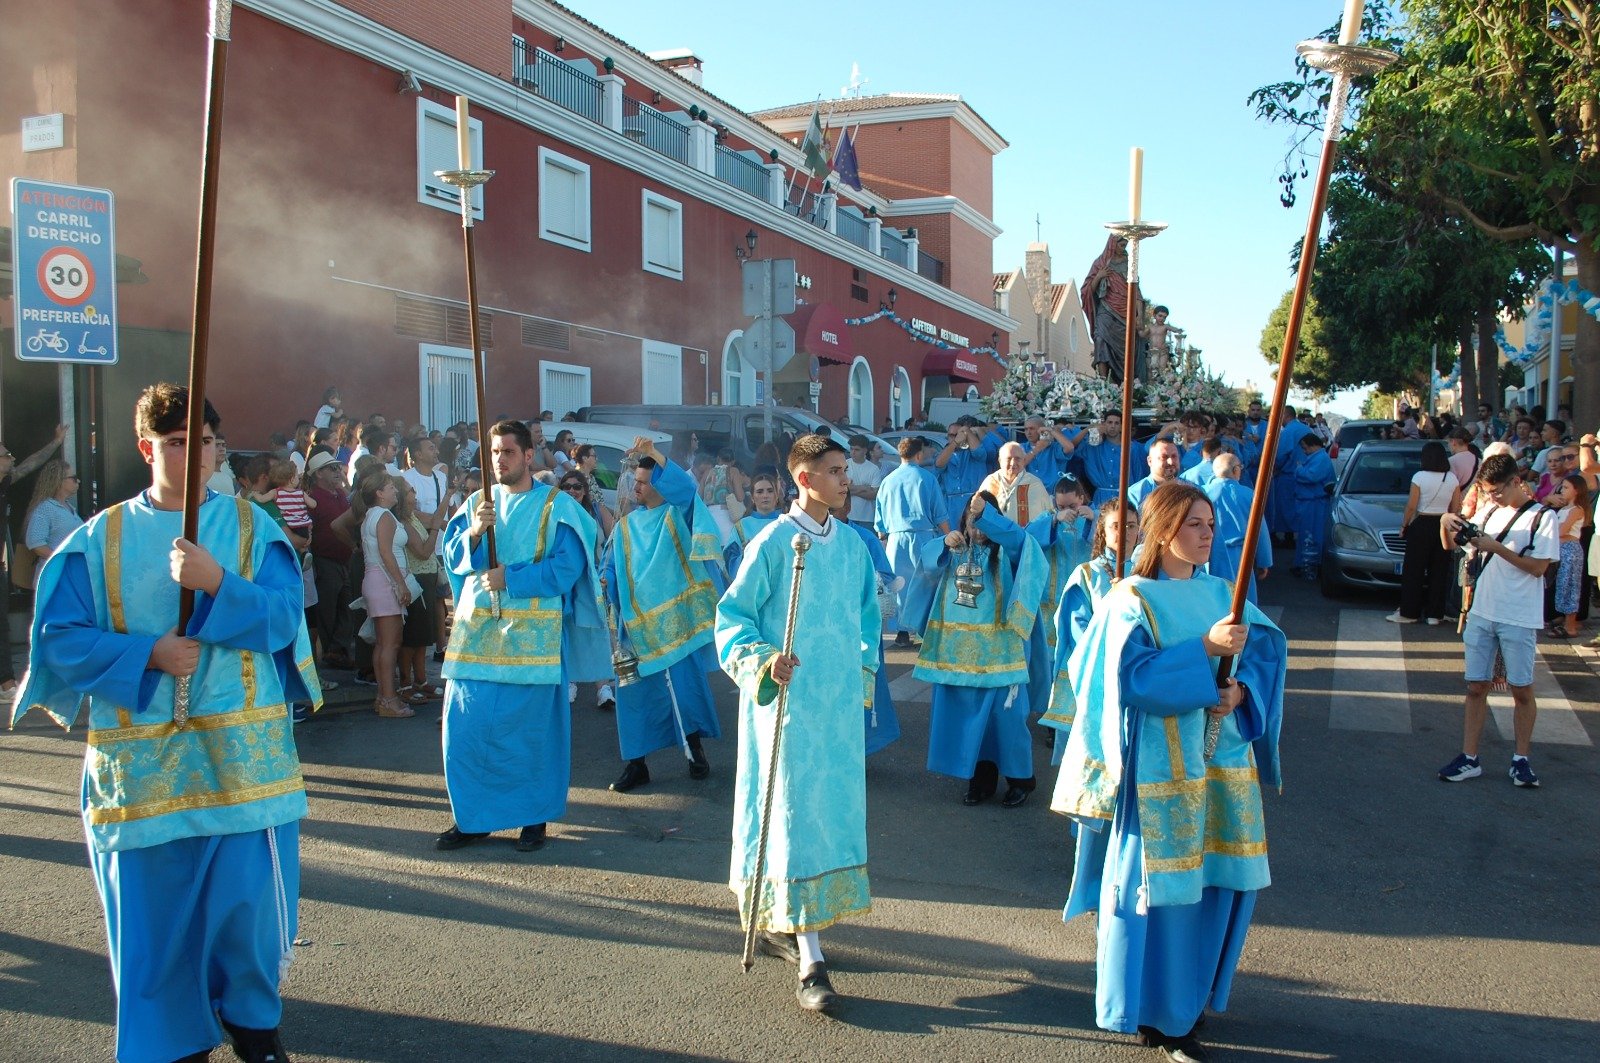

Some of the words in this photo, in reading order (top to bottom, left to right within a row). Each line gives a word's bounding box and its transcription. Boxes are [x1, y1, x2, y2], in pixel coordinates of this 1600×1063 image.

[21, 190, 108, 214] ATENCIÓN
[37, 210, 92, 228] CARRIL
[28, 226, 102, 245] DERECHO
[51, 266, 83, 287] 30
[22, 308, 111, 326] PREFERENCIA
[821, 330, 838, 345] HOTEL
